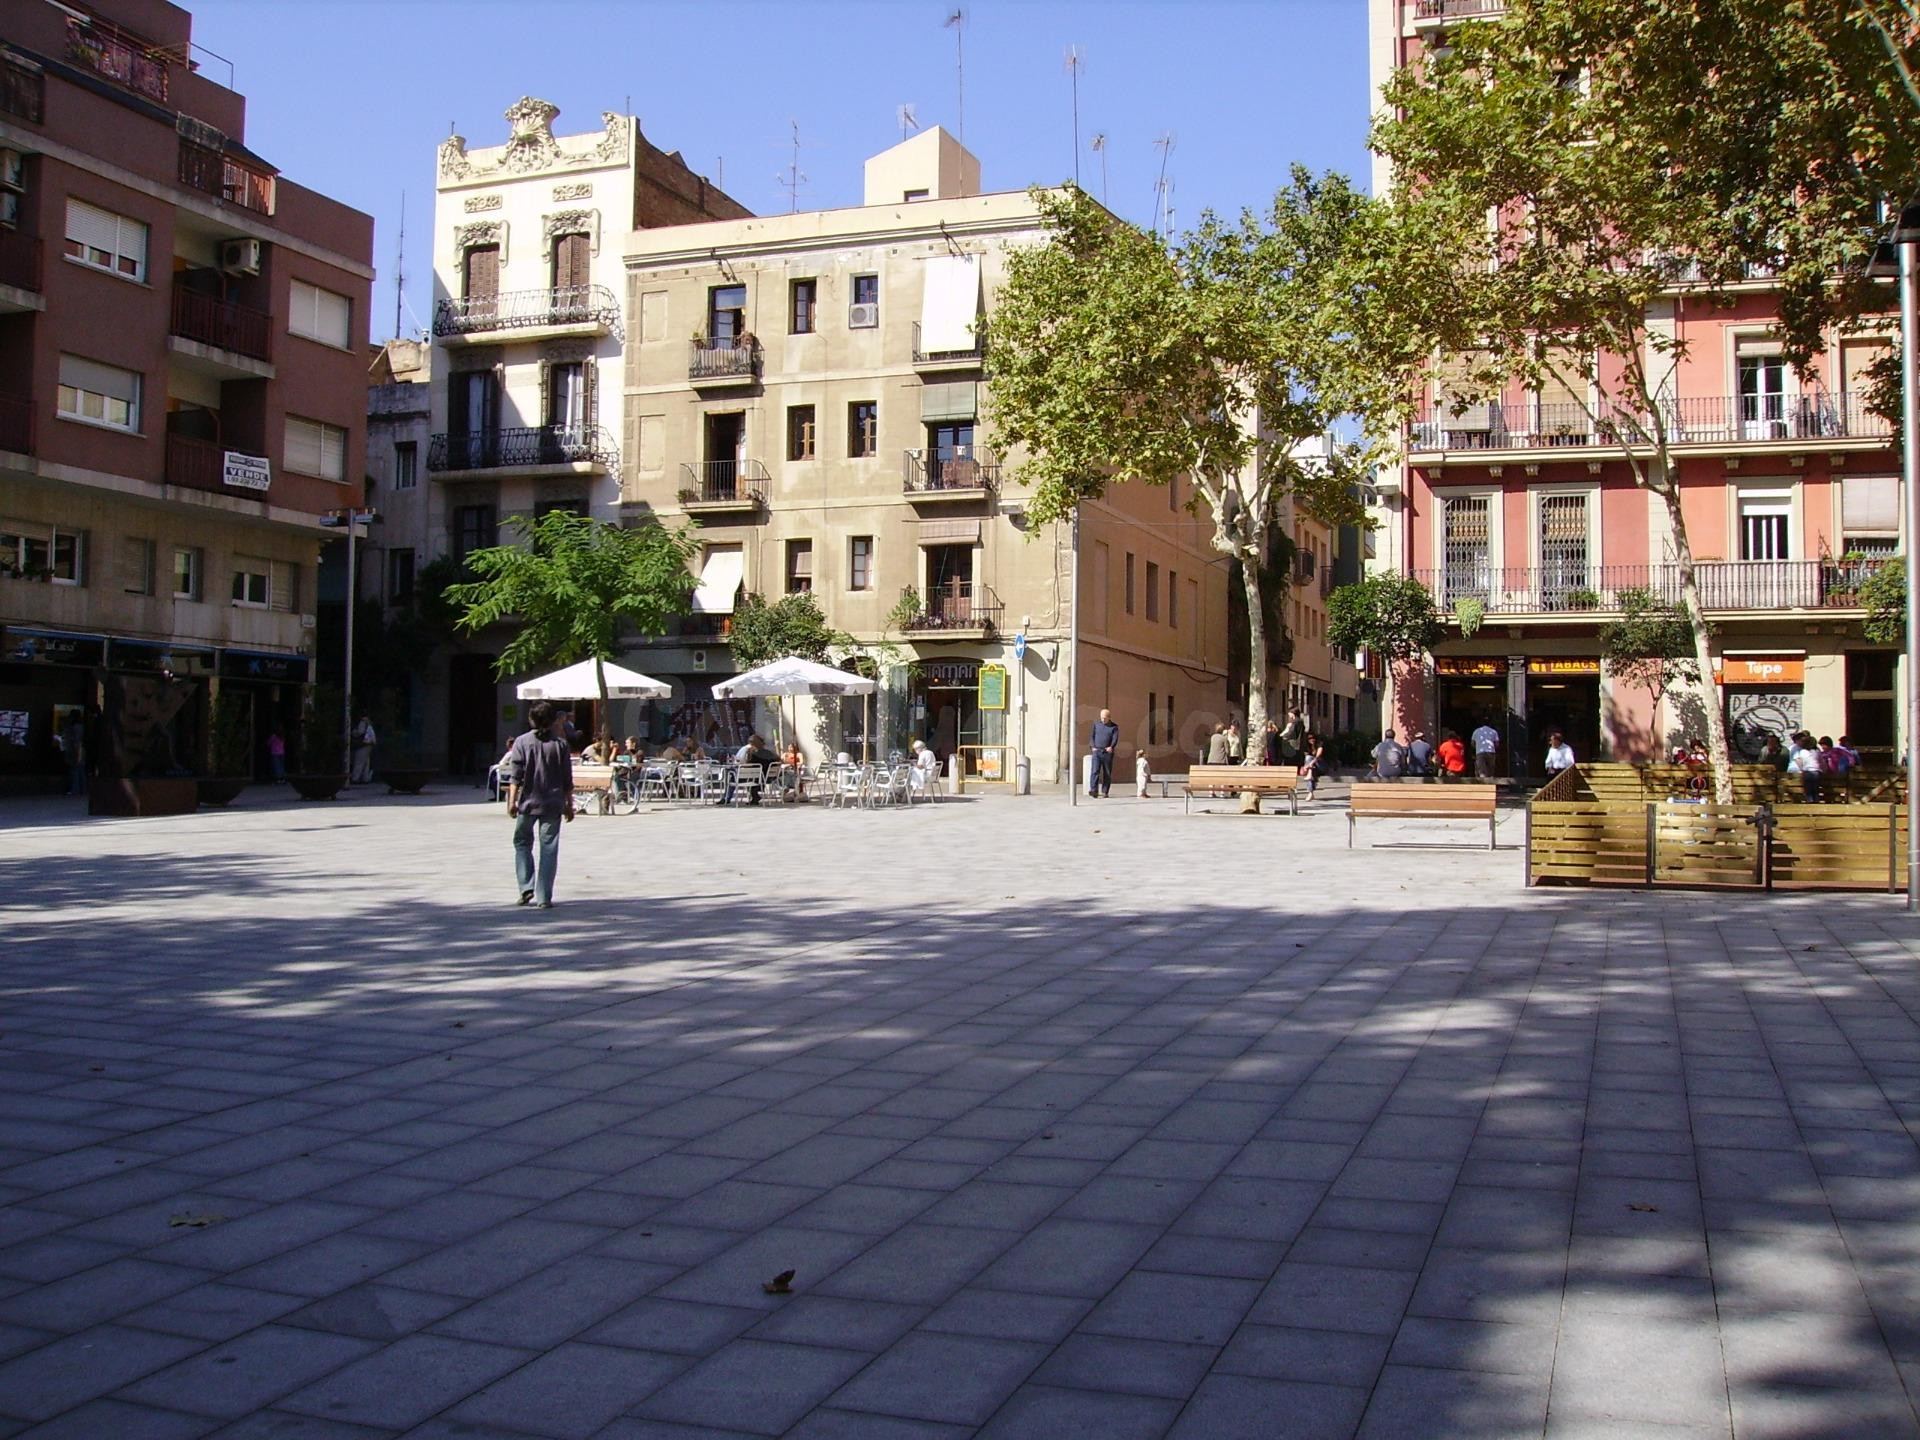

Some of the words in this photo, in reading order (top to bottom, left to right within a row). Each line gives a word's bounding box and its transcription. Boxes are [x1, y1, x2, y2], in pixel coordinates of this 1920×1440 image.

[229, 467, 266, 481] VENDE
[1456, 659, 1505, 669] TABACOS
[1550, 660, 1598, 669] TABACS
